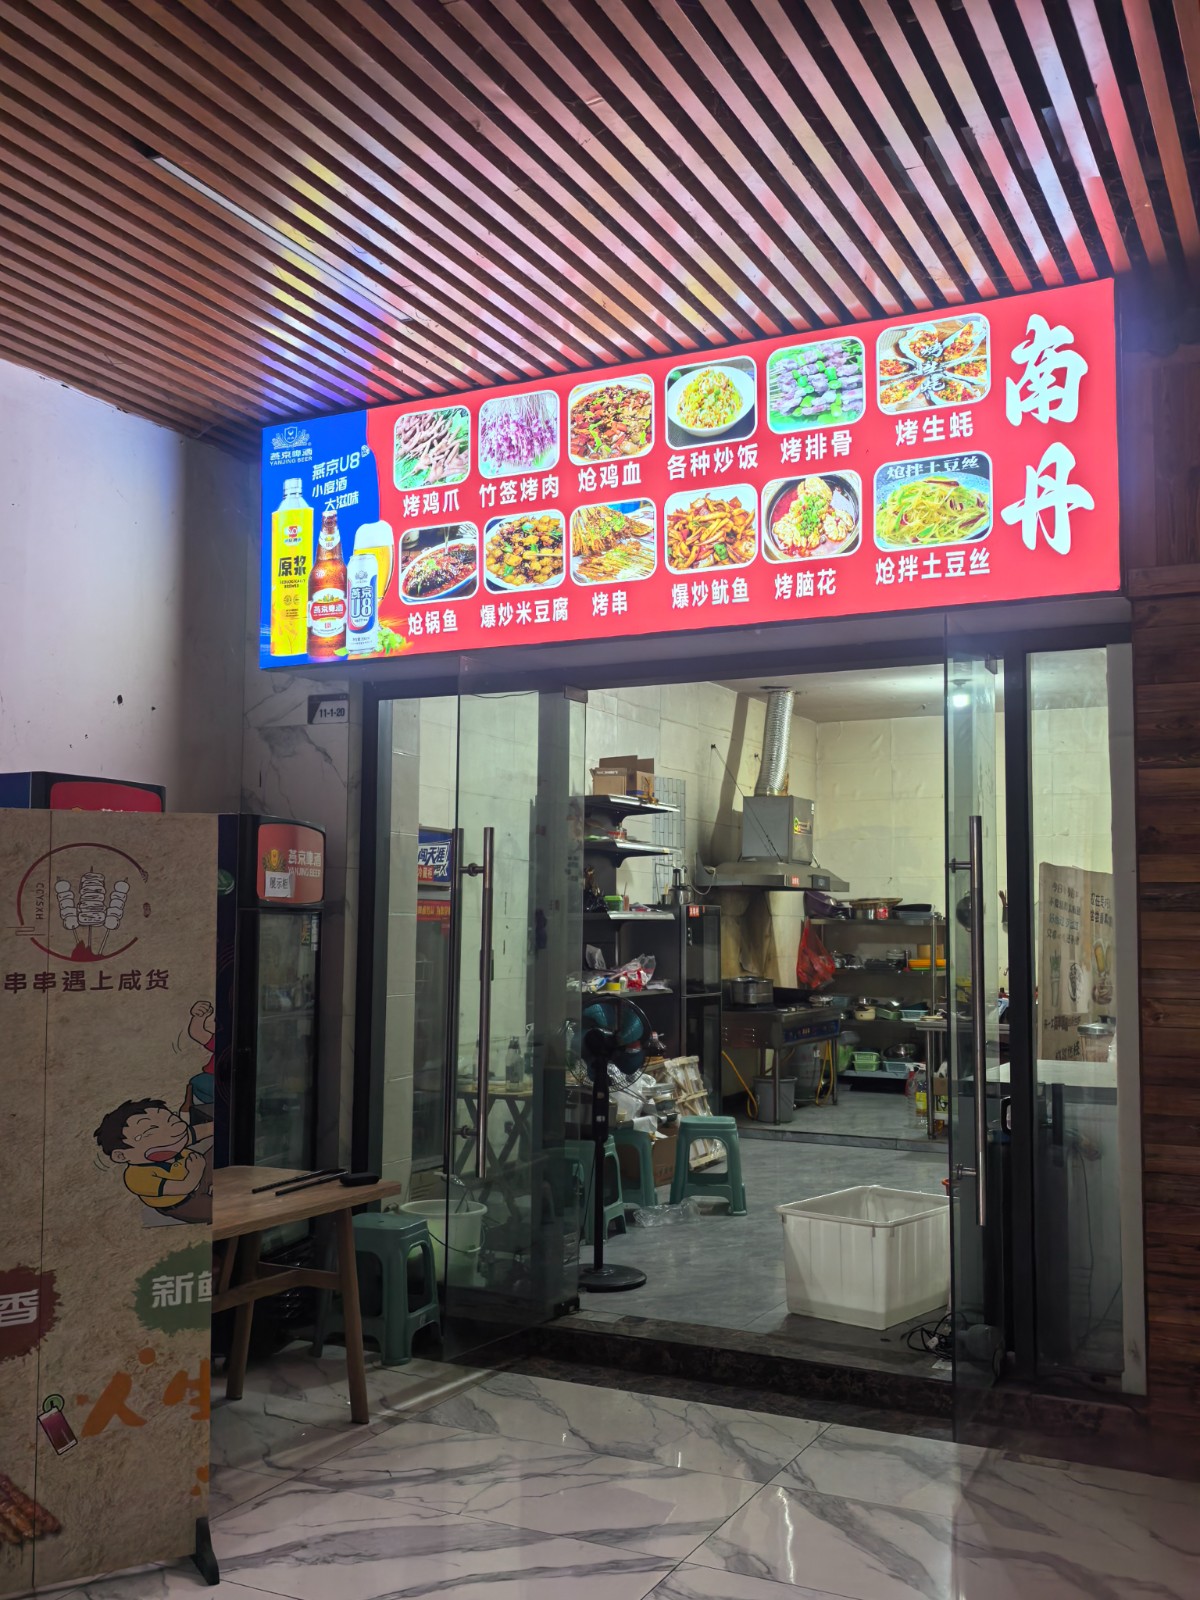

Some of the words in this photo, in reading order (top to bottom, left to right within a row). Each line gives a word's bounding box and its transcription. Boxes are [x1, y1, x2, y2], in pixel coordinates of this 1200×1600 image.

[895, 410, 974, 447] 烤生蚝
[1001, 313, 1096, 556] 南丹
[667, 443, 759, 481] 各种炒饭
[780, 430, 852, 465] 烤排骨
[312, 476, 347, 498] 小度酒
[479, 474, 560, 508] 竹签烤肉
[578, 461, 642, 493] 炝鸡血
[324, 491, 360, 512] 大滋味
[402, 488, 460, 518] 烤鸡爪
[278, 555, 307, 577] 原浆
[875, 547, 991, 587] 炝拌土豆丝
[671, 576, 750, 610] 爆炒鱿鱼
[774, 568, 837, 600] 烤脑花
[351, 599, 372, 618] U8
[479, 597, 568, 629] 爆炒米豆腐
[592, 589, 628, 617] 烤串
[408, 609, 458, 636] 炝锅鱼
[319, 707, 346, 718] 11-1-20
[4, 969, 169, 994] 串串遇上咸货
